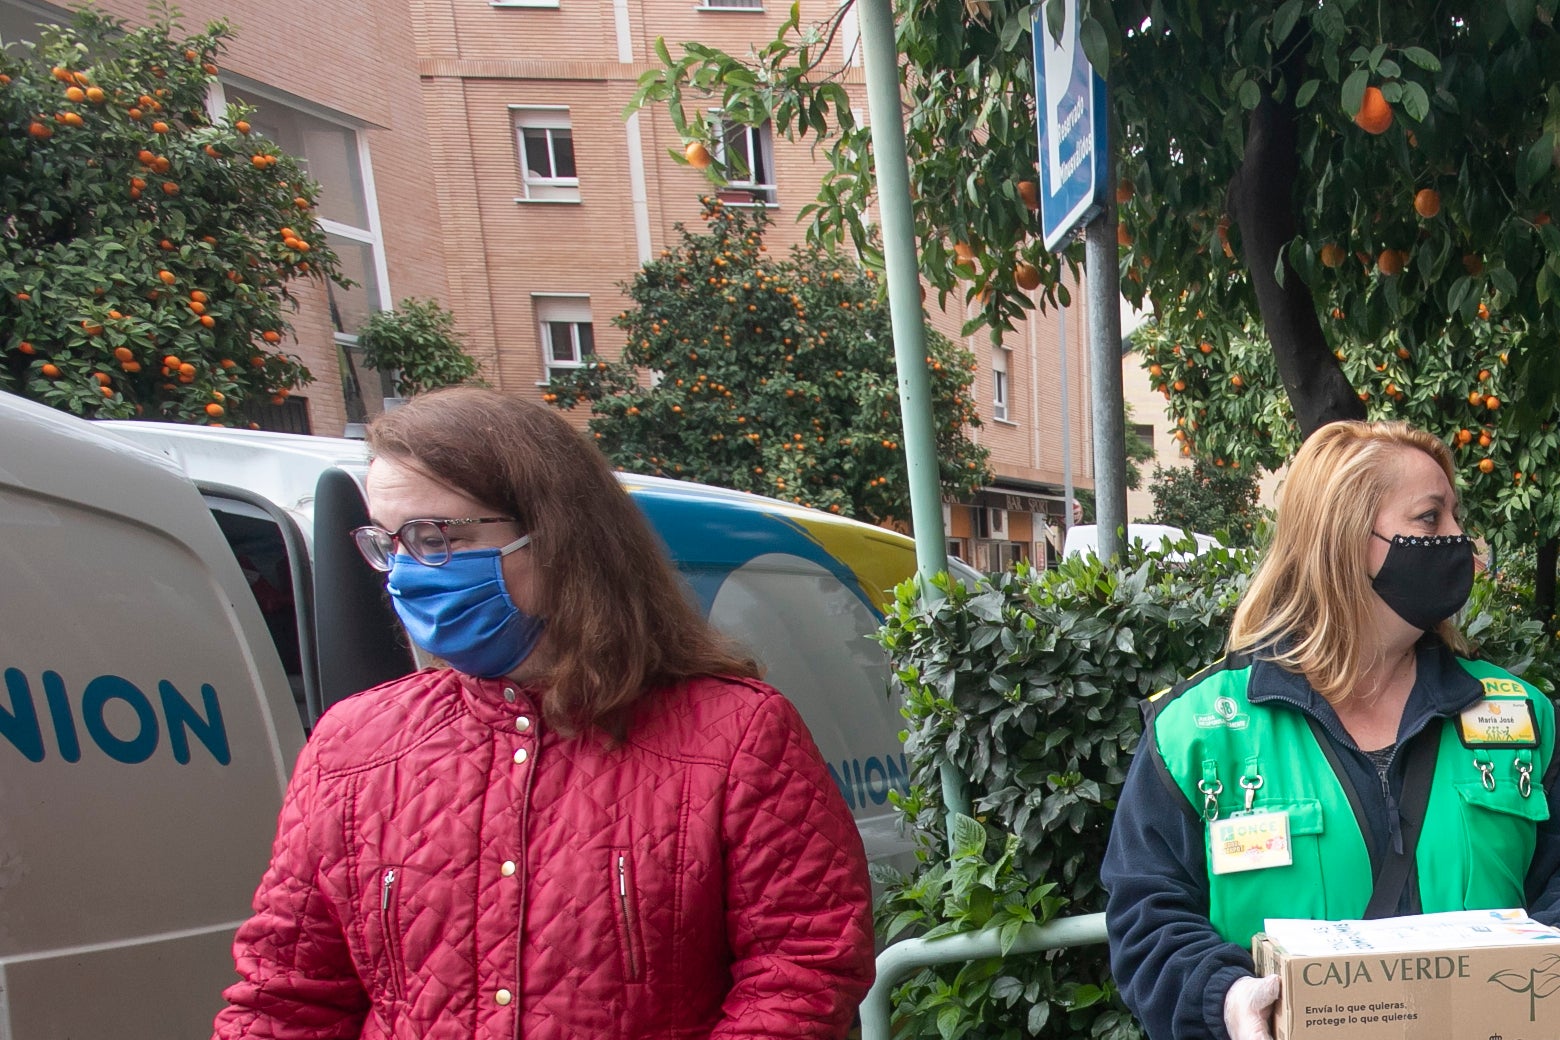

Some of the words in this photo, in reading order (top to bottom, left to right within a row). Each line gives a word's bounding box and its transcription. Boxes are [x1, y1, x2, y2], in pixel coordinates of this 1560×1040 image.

[1057, 95, 1084, 144] Reservado
[1006, 494, 1022, 511] BAR
[1028, 496, 1049, 514] SPORT
[1238, 821, 1277, 836] ONCE
[1303, 960, 1373, 988] CAJA
[1380, 955, 1470, 982] VERDE
[1305, 1004, 1333, 1014] Envía
[1335, 1004, 1345, 1013] lo
[1347, 1005, 1366, 1013] que
[1306, 1016, 1346, 1028] protege
[1348, 1014, 1358, 1023] lo
[1360, 1015, 1379, 1024] que
[1381, 1012, 1418, 1022] quieres
